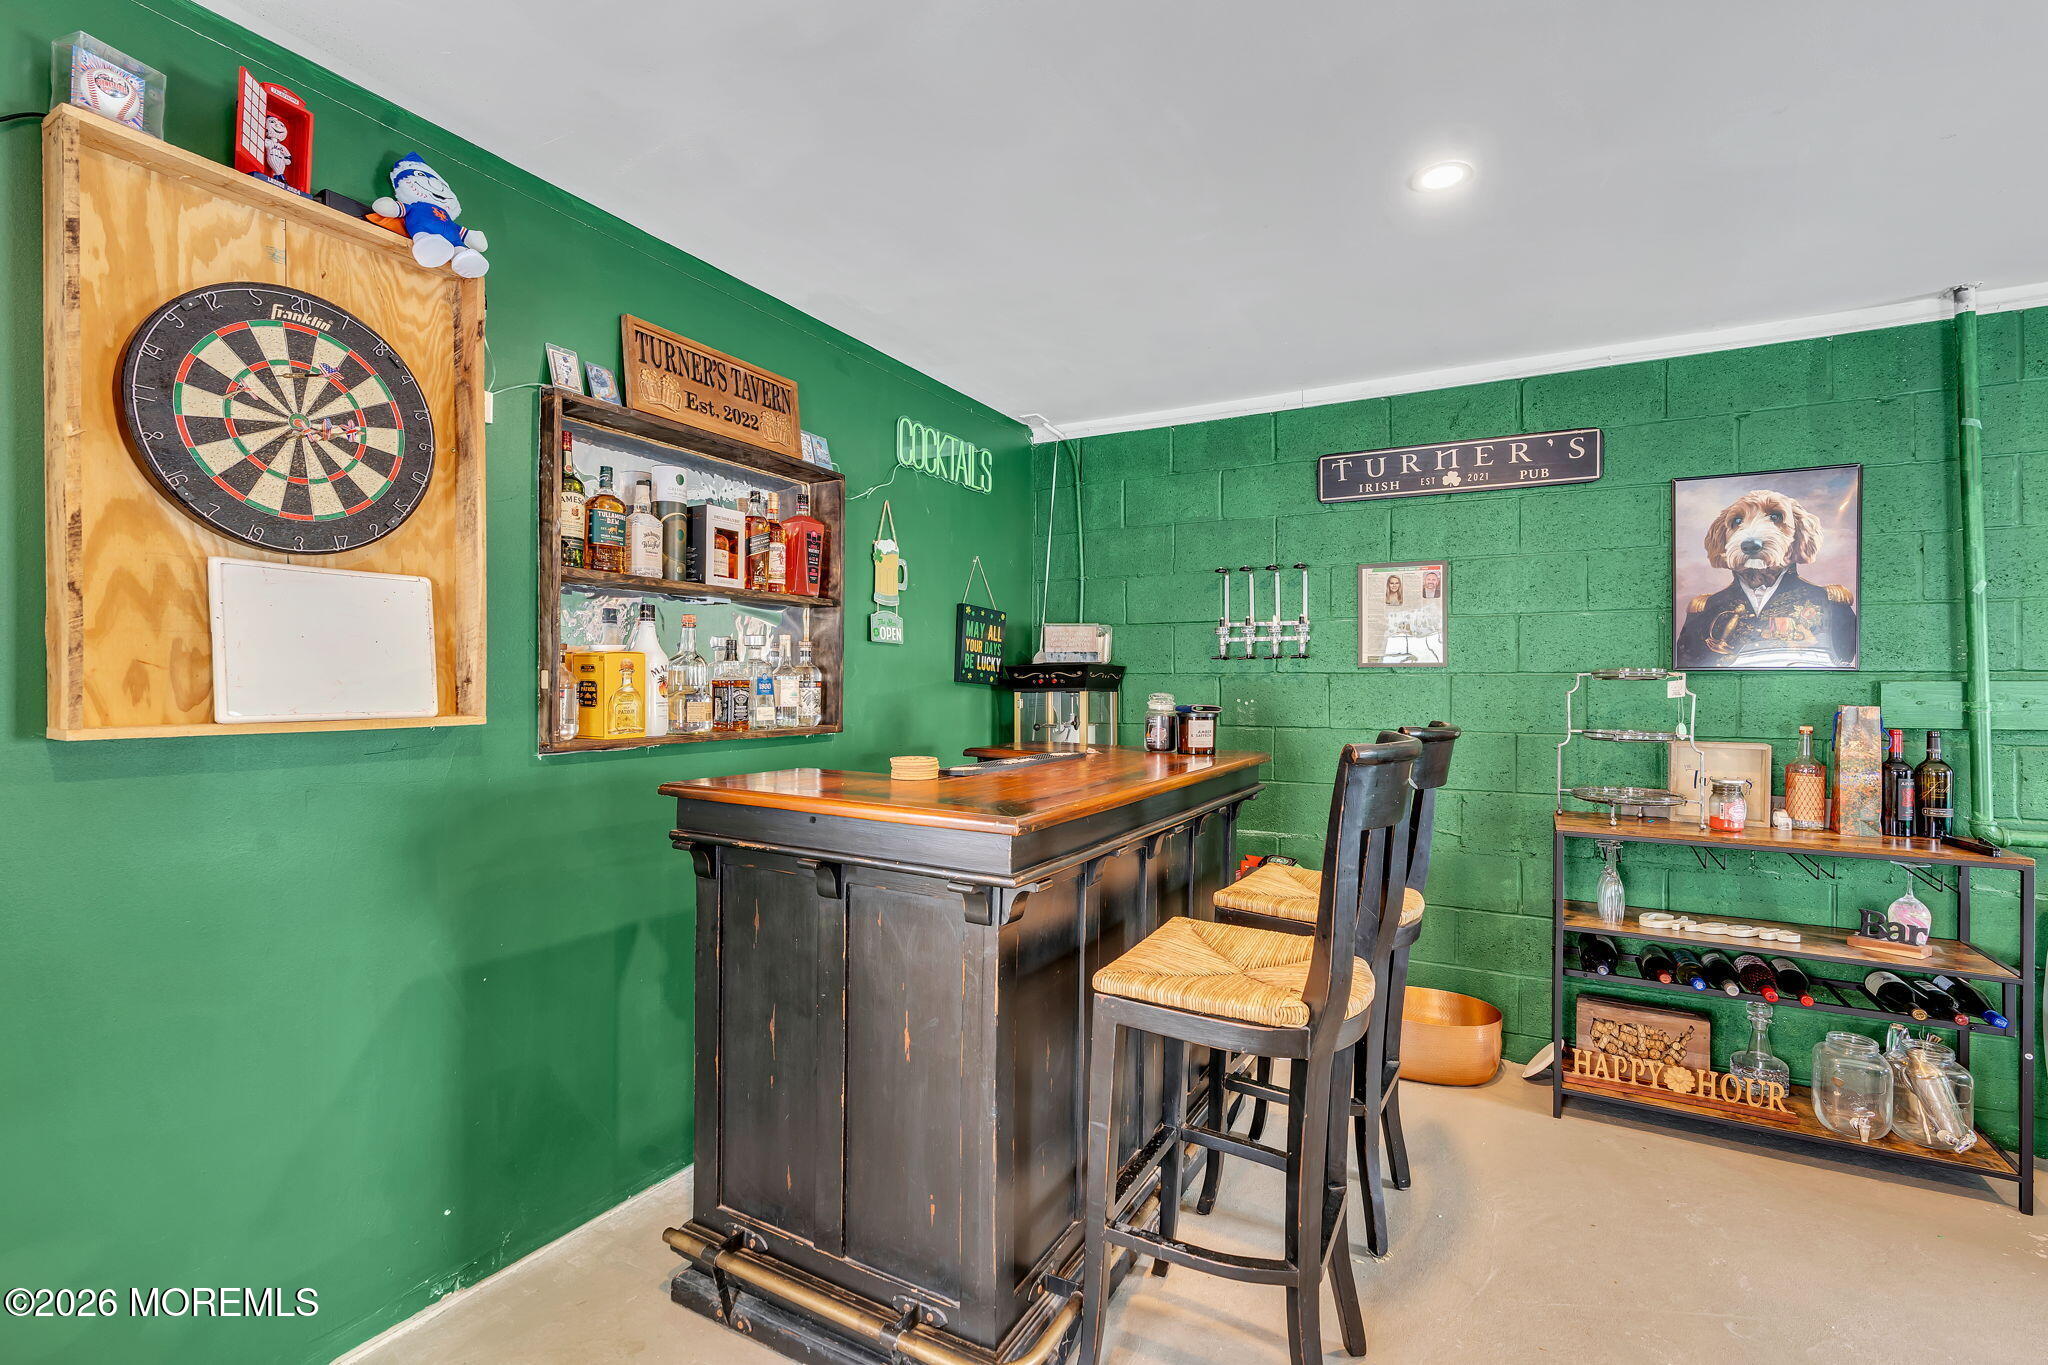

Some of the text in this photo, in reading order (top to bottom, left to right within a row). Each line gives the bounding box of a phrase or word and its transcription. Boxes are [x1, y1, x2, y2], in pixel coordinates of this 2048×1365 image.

[200, 291, 224, 312] 12
[249, 289, 263, 306] 5
[291, 296, 312, 315] 20
[165, 313, 184, 329] 9
[271, 303, 333, 331] Franklin
[340, 315, 350, 330] 1
[141, 343, 164, 360] 14
[373, 341, 388, 356] 18
[401, 374, 413, 386] 4
[635, 330, 792, 414] TURNER'S TAVERN
[413, 410, 428, 421] 13
[684, 390, 760, 431] Est. 2022
[143, 432, 163, 441] 8
[899, 417, 992, 493] COCKTAILS
[1331, 436, 1586, 482] TURNER'S
[165, 469, 188, 486] 16
[1359, 468, 1550, 493] IRISH PUB
[1420, 472, 1489, 486] EST 2021
[206, 504, 221, 517] 7
[394, 499, 410, 516] 15
[245, 527, 264, 541] 19
[369, 523, 379, 537] 2
[294, 536, 304, 550] 3
[333, 535, 348, 550] 17
[880, 626, 902, 642] OPEN
[966, 620, 1002, 642] MAY ALL
[965, 638, 1002, 657] YOUR DAYS
[964, 653, 1002, 673] BE LUCKY
[1858, 908, 1929, 947] Bar
[1572, 1048, 1797, 1115] HAPPY HOUR
